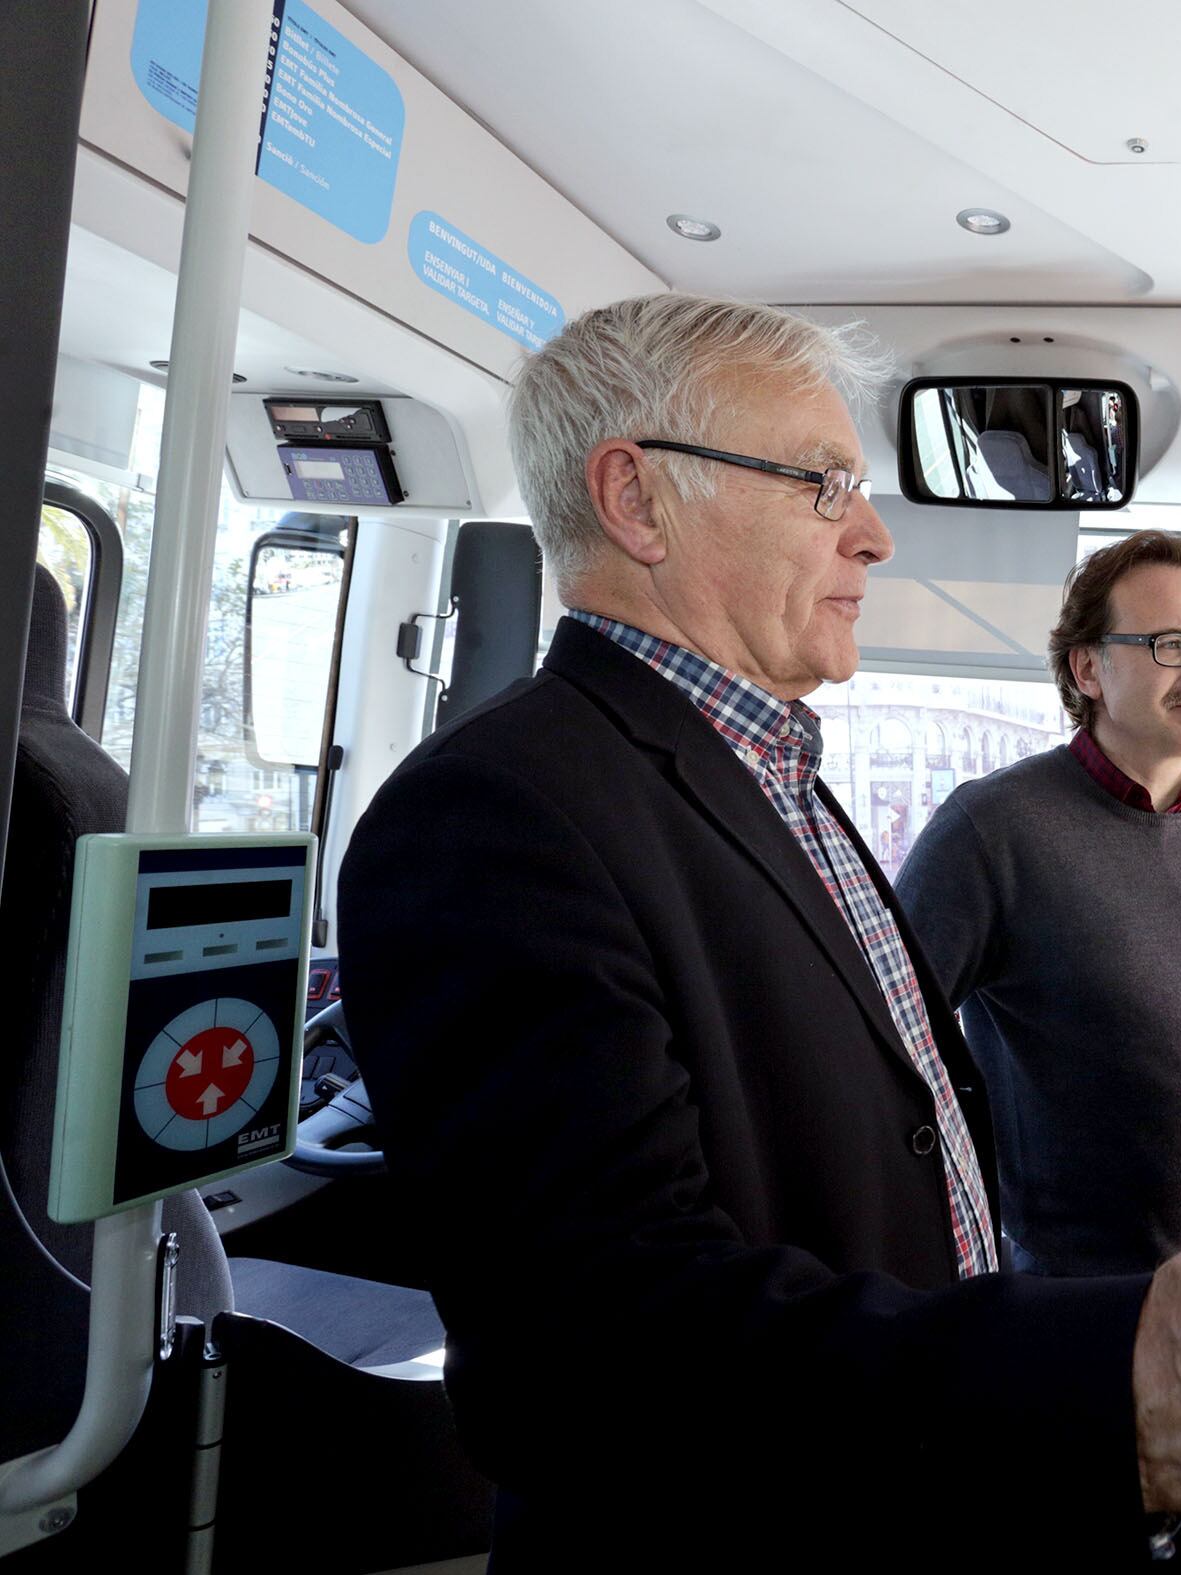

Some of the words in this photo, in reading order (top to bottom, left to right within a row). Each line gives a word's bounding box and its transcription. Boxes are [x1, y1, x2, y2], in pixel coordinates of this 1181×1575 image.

[428, 221, 497, 275] BENVINGUT/UDA
[423, 264, 456, 291] VALIDAR
[501, 271, 558, 316] BIENVENIDO/A
[238, 1123, 281, 1145] EMT
